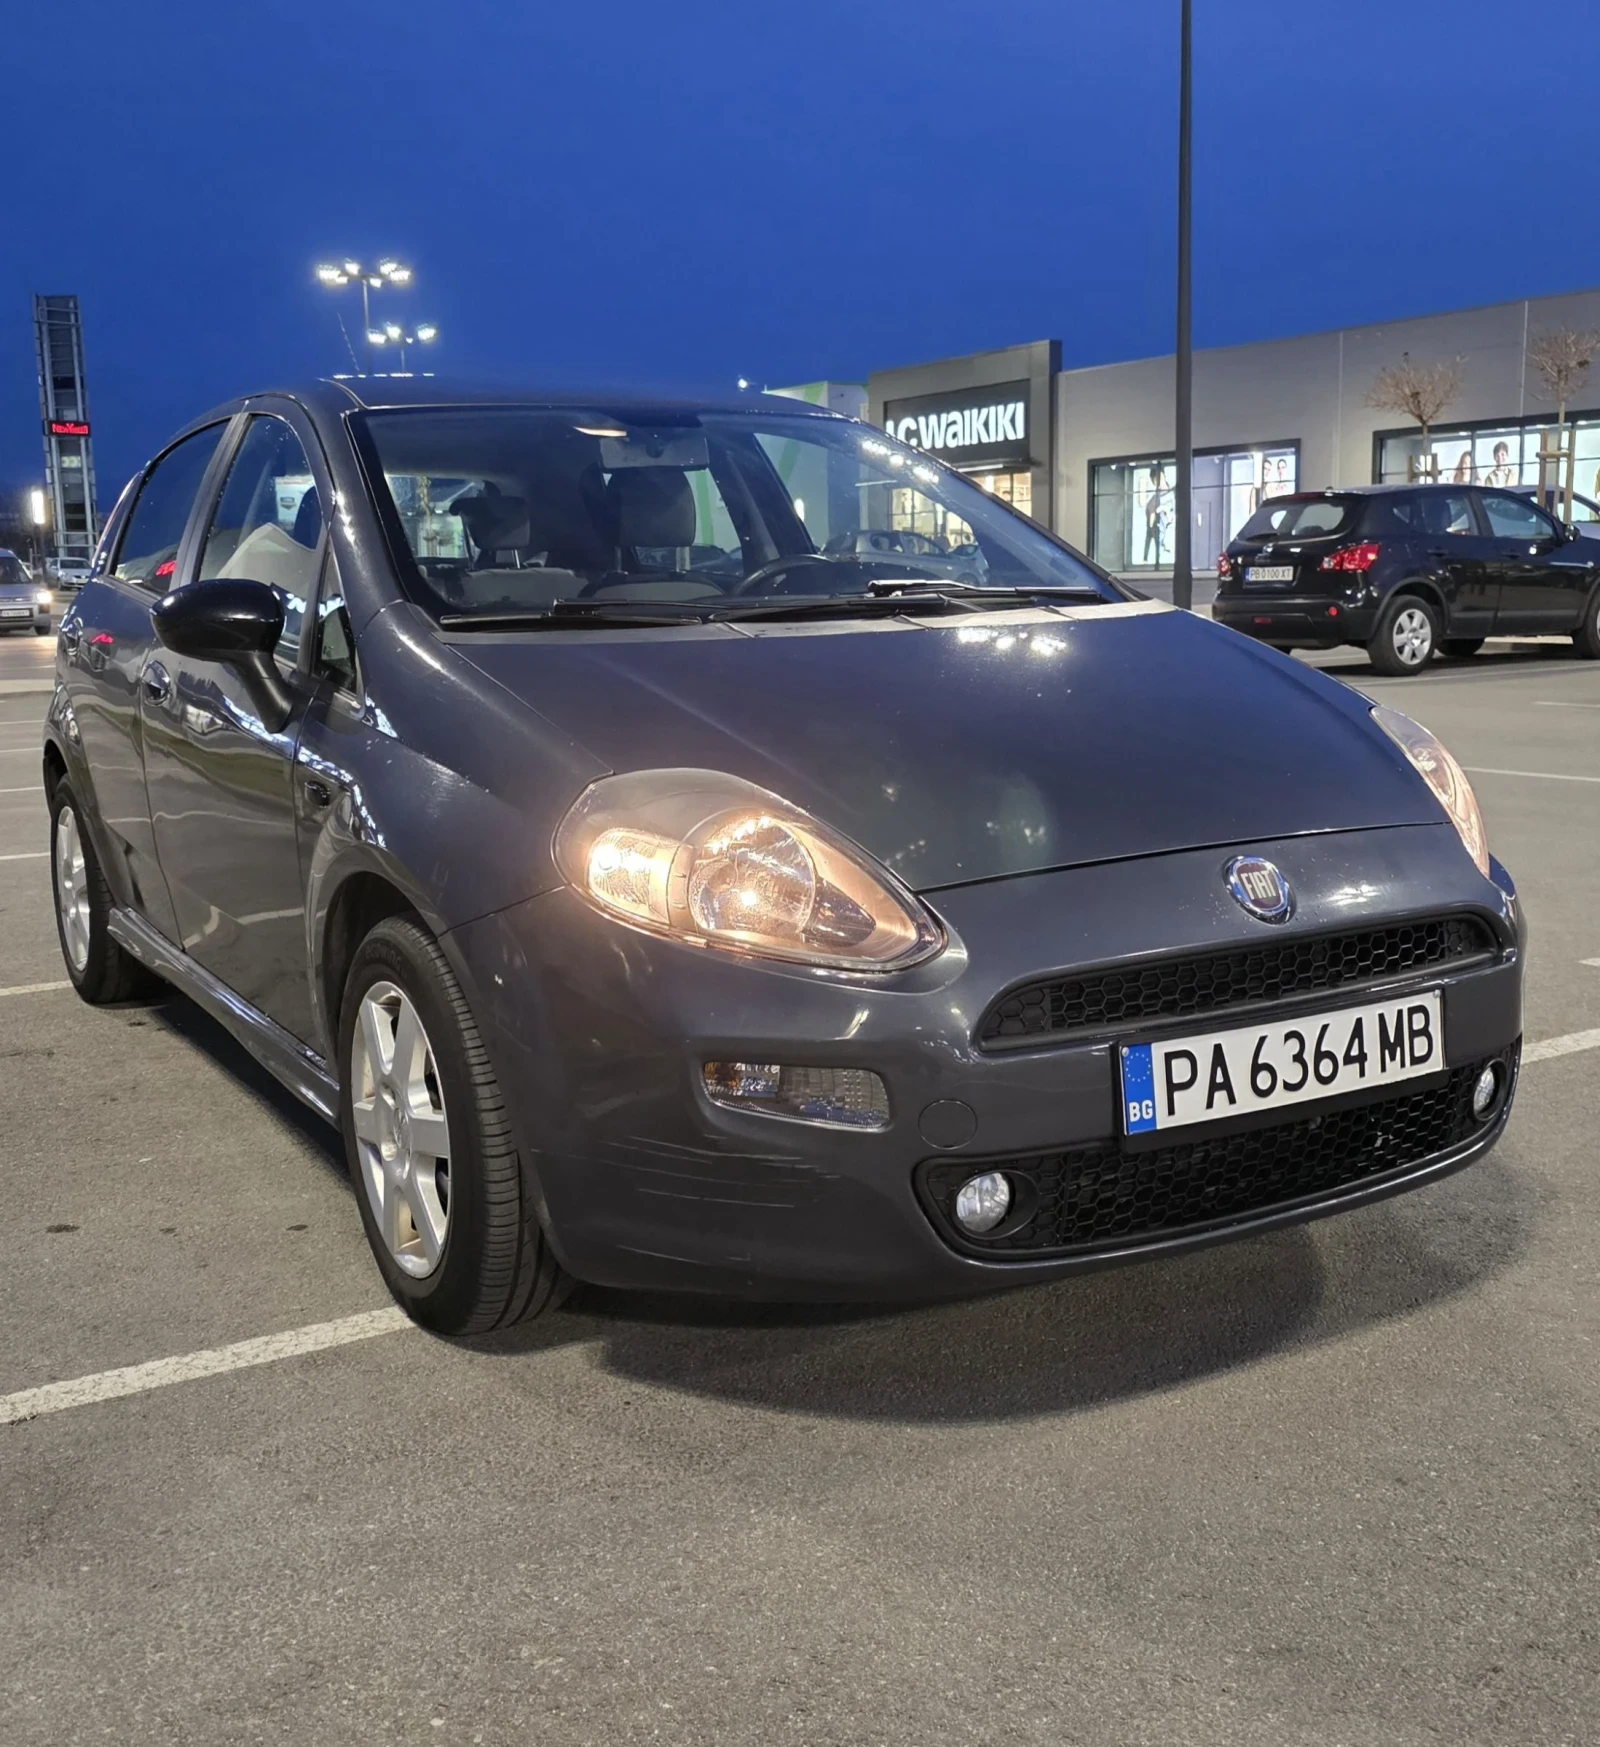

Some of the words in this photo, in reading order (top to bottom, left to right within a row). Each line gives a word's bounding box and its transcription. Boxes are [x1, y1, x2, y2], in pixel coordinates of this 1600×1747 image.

[1250, 568, 1260, 579] PB
[1262, 568, 1279, 579] 0100
[1240, 870, 1277, 900] FIAT
[1163, 1043, 1237, 1117] PA
[1250, 1017, 1368, 1098] 6364
[1377, 1004, 1434, 1074] MB
[1129, 1100, 1153, 1122] BG
